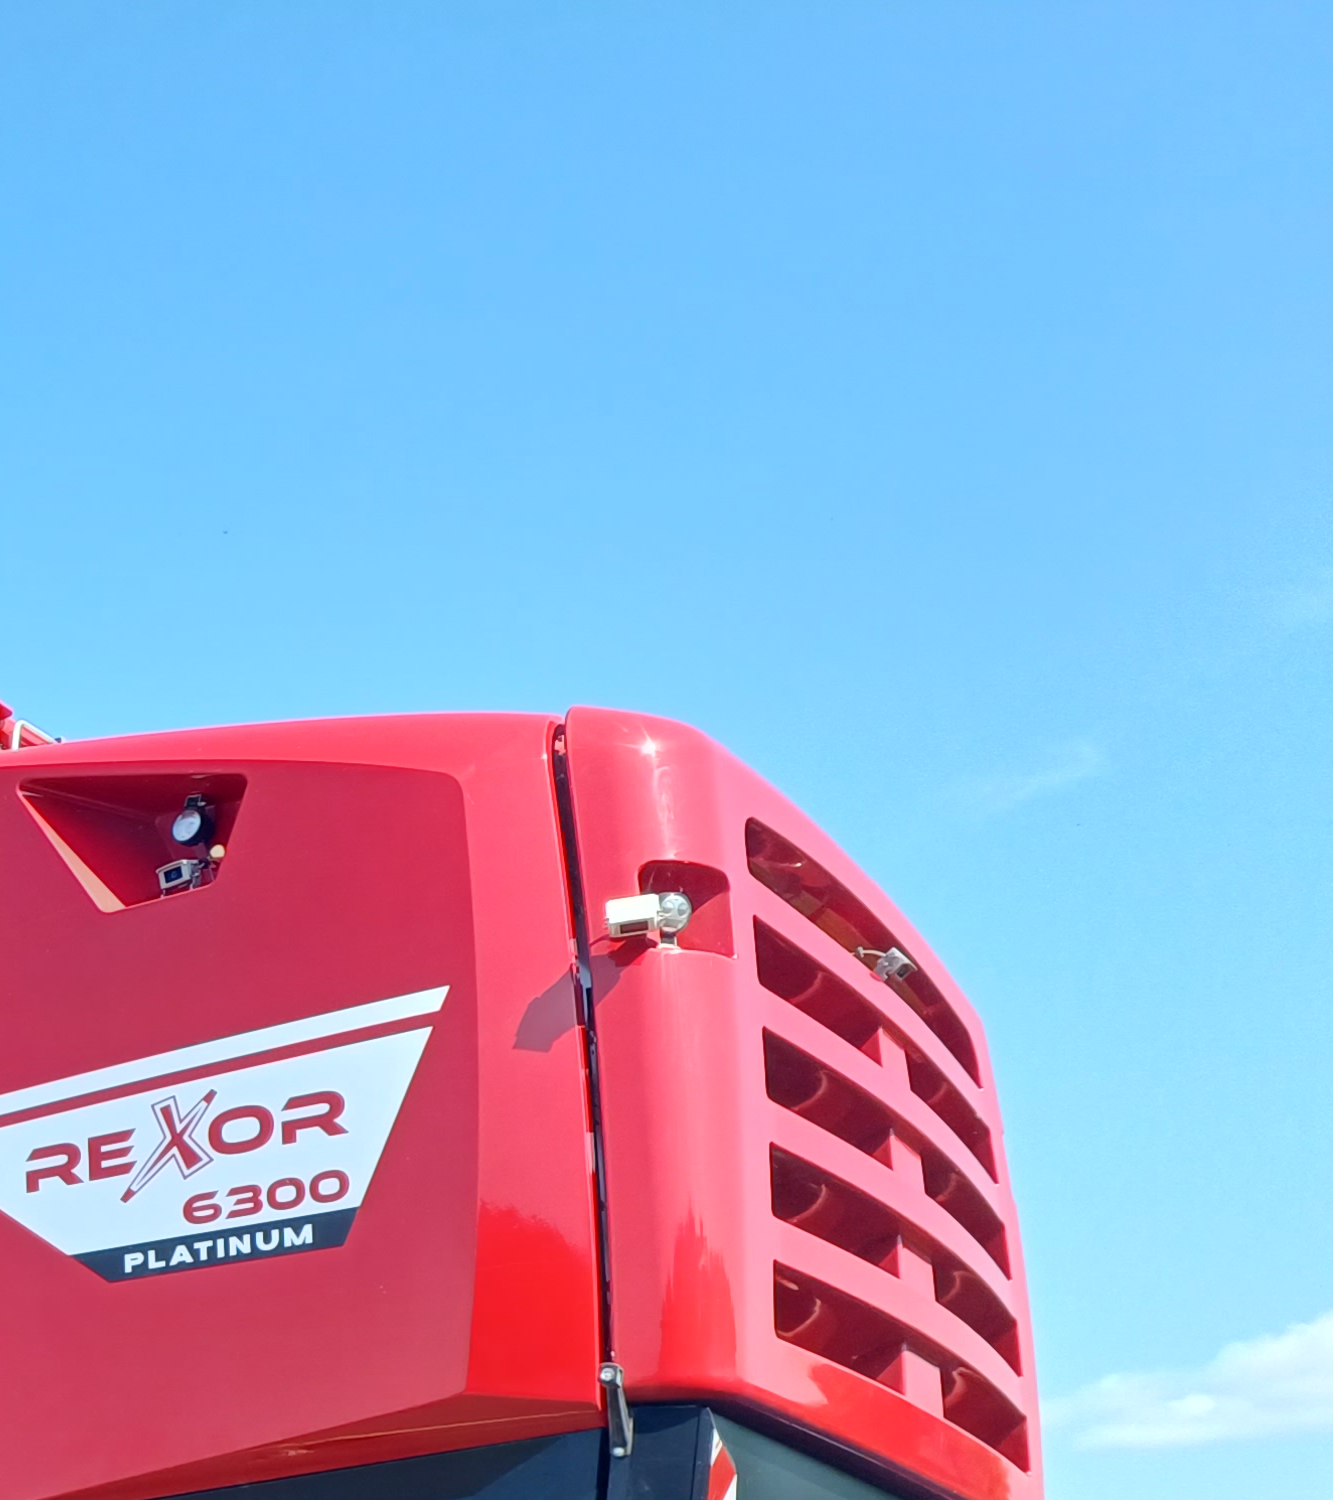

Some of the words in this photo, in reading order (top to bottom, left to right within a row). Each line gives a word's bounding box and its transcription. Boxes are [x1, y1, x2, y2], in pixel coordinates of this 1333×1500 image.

[25, 1088, 350, 1204] REXOR
[182, 1169, 351, 1225] 6300
[123, 1223, 314, 1274] PLATINUM
